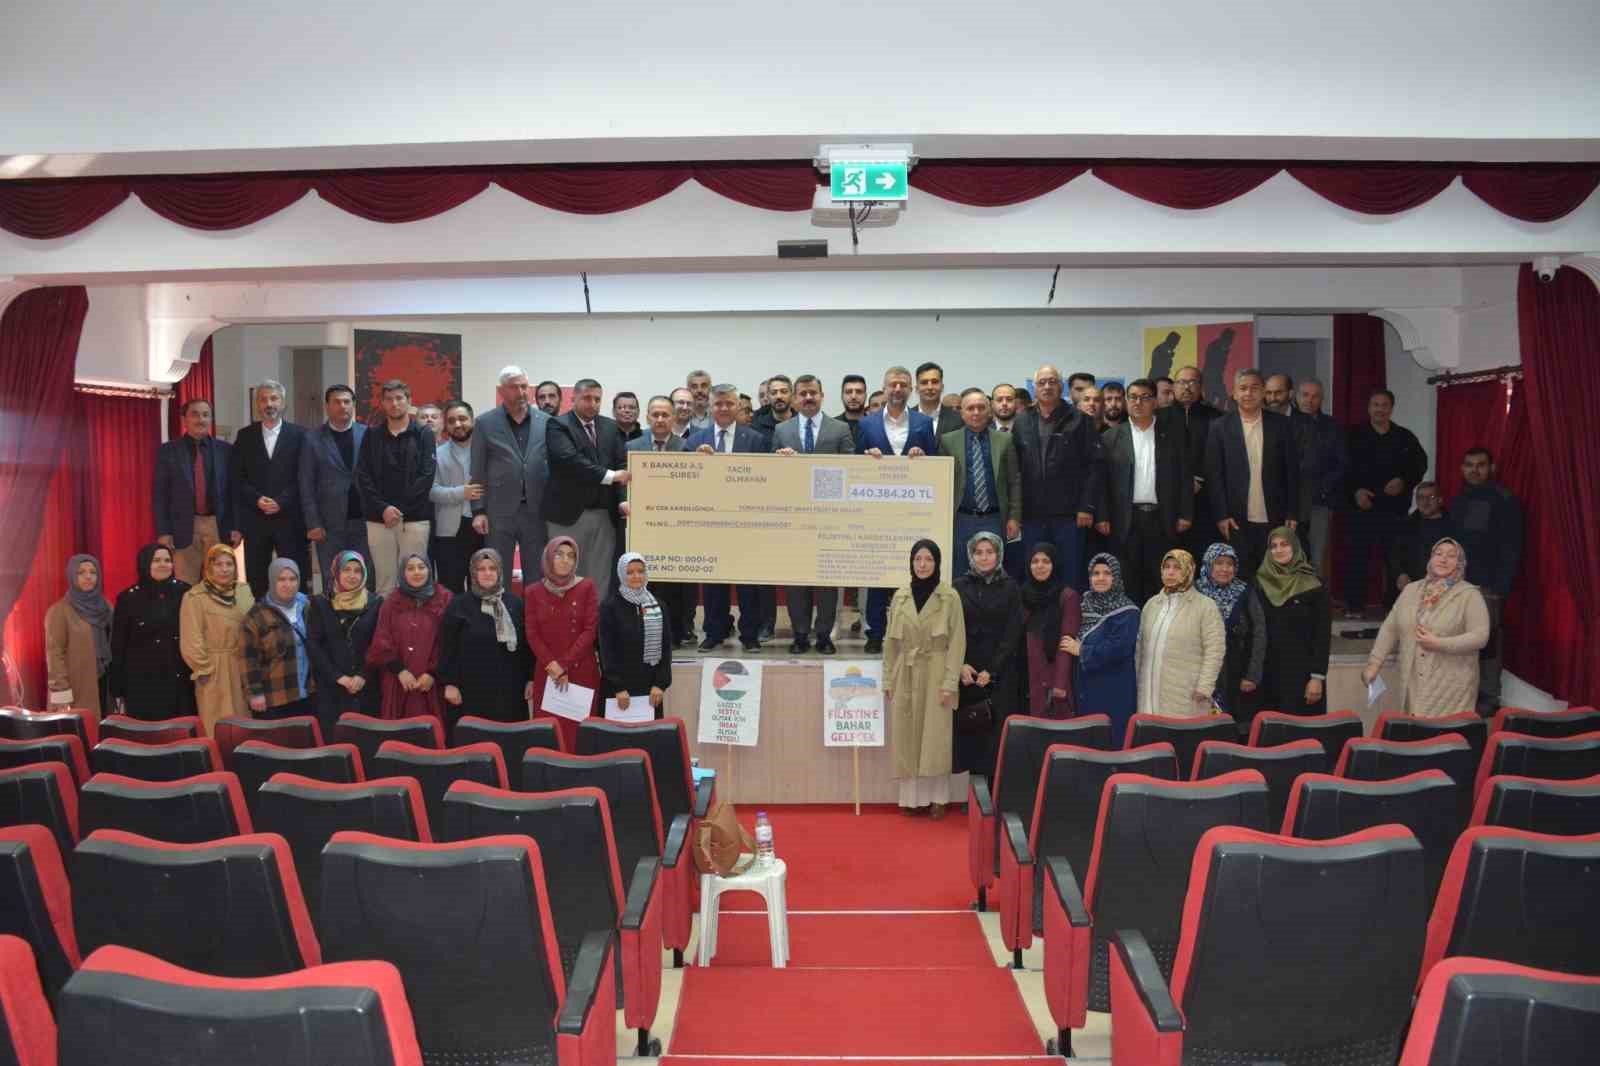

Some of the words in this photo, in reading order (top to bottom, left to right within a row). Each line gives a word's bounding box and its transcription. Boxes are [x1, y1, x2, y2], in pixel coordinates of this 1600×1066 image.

[851, 487, 916, 499] 440.384.20
[918, 488, 934, 499] TL
[647, 563, 659, 571] EK
[835, 720, 872, 731] BAHAR
